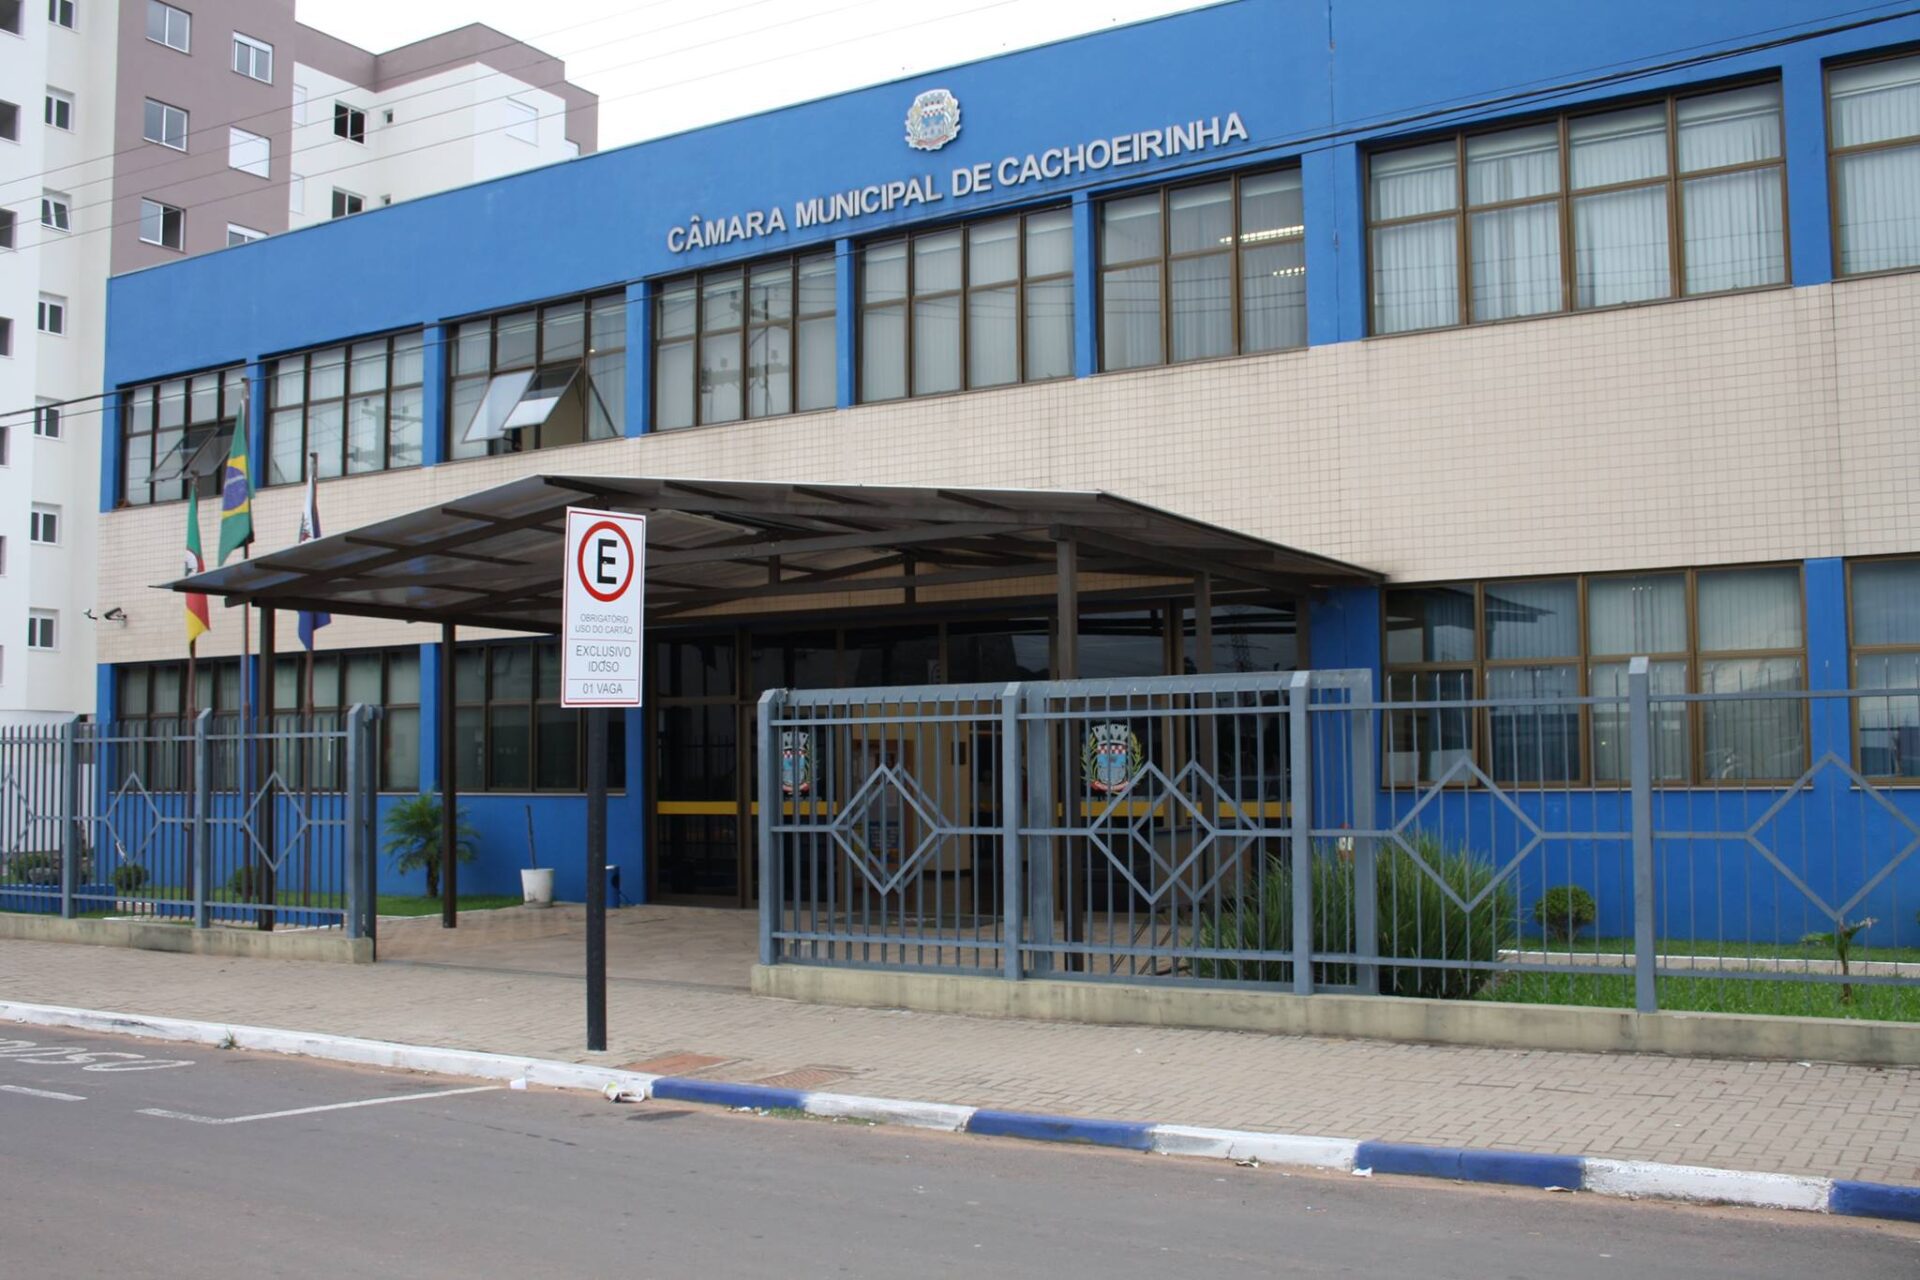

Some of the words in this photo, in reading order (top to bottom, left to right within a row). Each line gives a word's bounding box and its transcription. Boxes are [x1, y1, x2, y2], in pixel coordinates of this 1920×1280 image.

[667, 205, 786, 253] CÂMARA
[795, 174, 942, 228] MUNICIPAL
[952, 163, 992, 197] DE
[997, 112, 1248, 186] CACHOEIRINHA
[597, 538, 617, 585] E
[575, 624, 591, 633] USO
[592, 625, 603, 634] DO
[605, 624, 633, 635] CARTÃO
[576, 645, 631, 658] EXCLUSIVO
[588, 660, 619, 673] IDOSO
[582, 682, 593, 694] 01
[597, 682, 623, 694] VAGA
